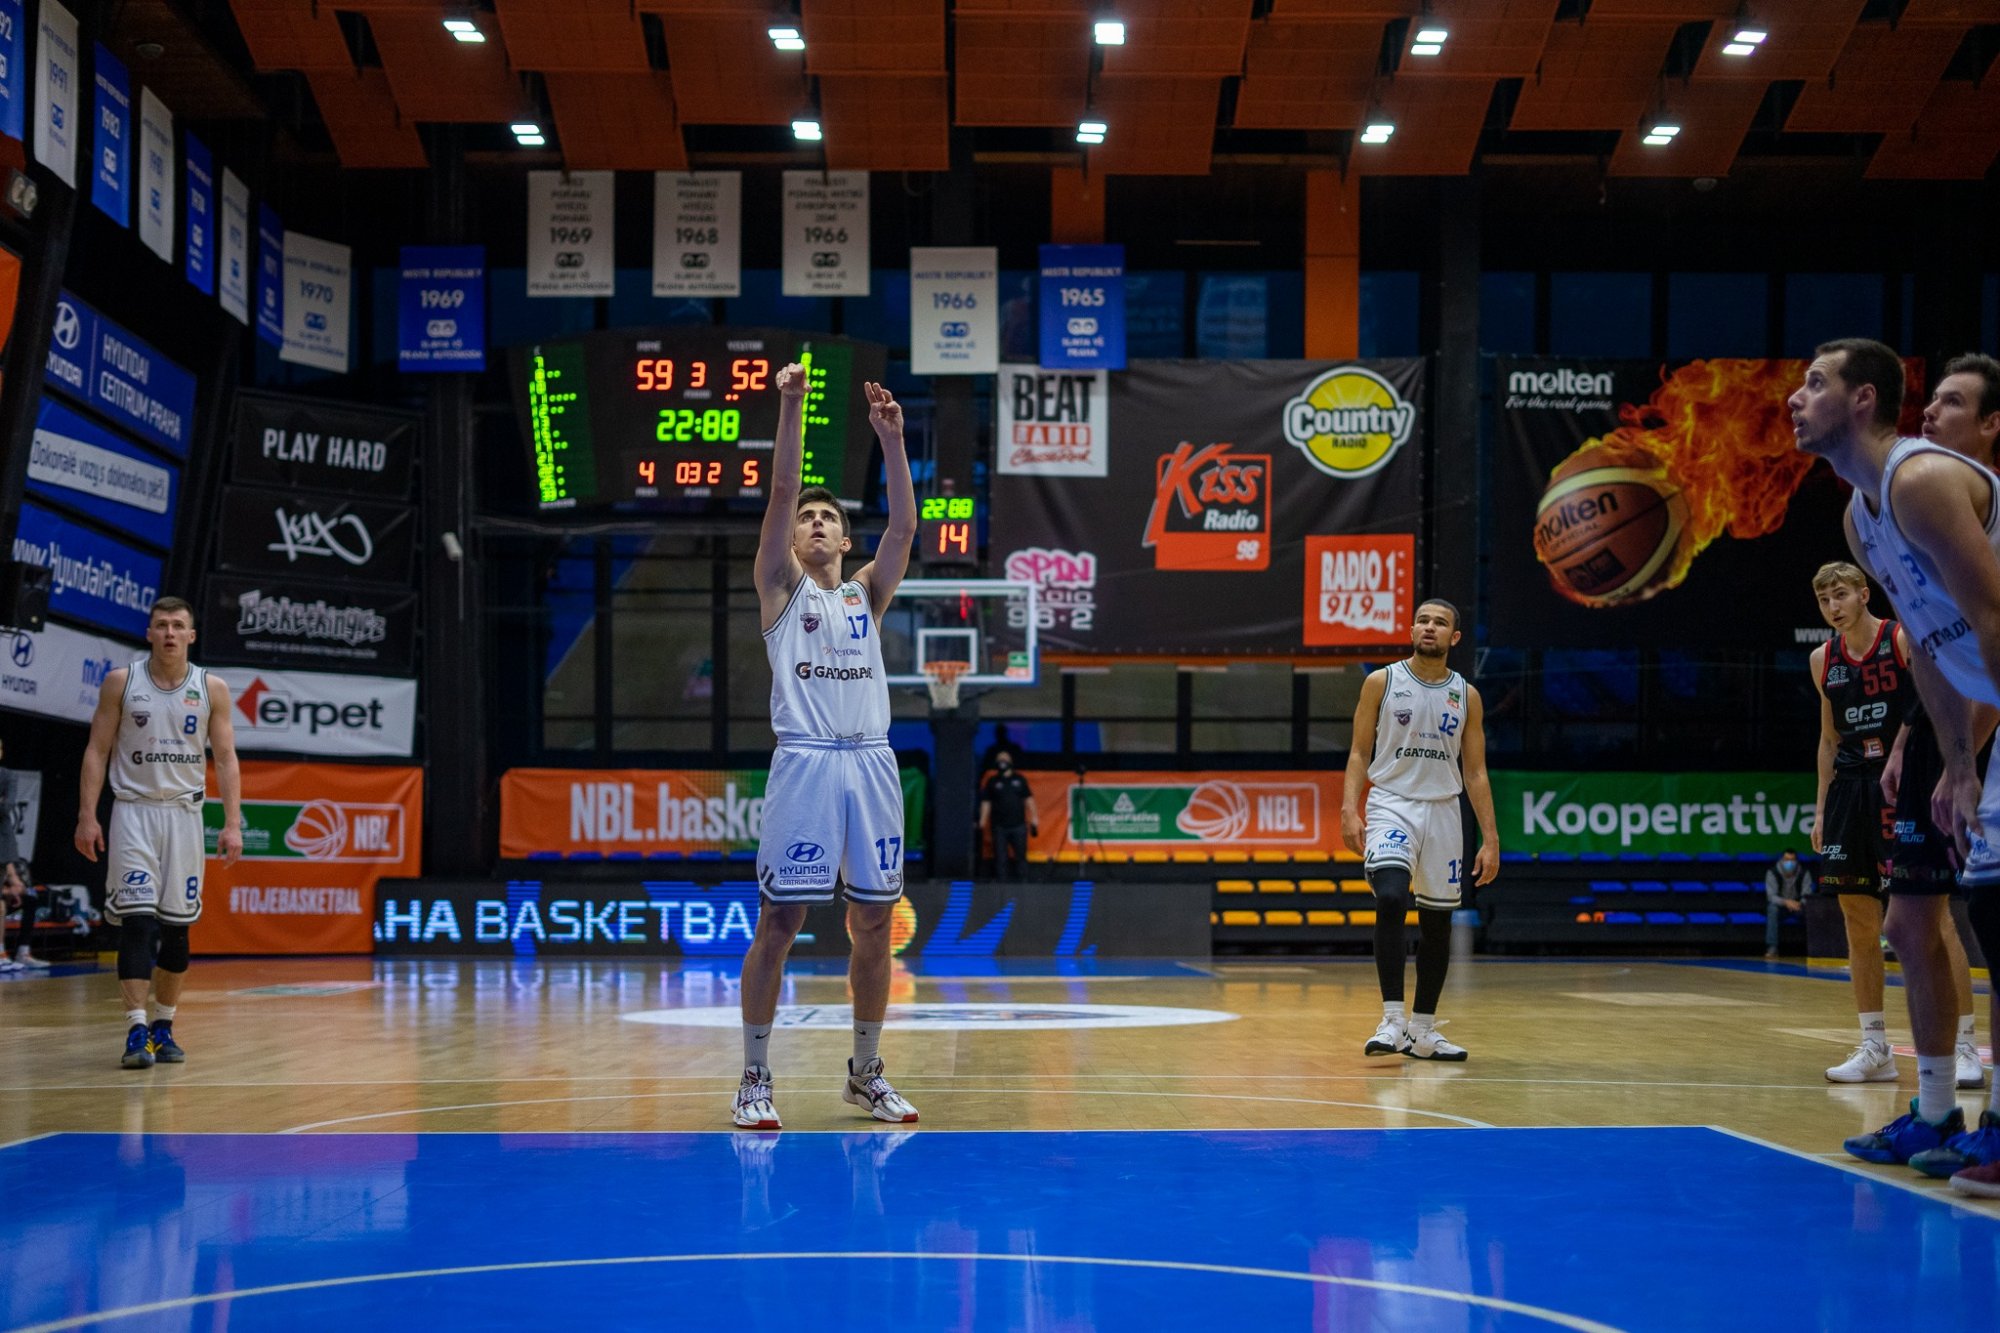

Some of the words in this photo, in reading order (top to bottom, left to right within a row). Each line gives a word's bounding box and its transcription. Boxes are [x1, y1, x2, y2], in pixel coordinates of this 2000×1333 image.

[549, 227, 593, 245] 1969
[675, 227, 719, 245] 1968
[804, 227, 848, 244] 1966
[300, 280, 334, 305] 1970
[420, 289, 465, 309] 1969
[932, 292, 977, 310] 1966
[1060, 288, 1105, 307] 1965
[636, 359, 674, 391] 59
[690, 361, 706, 388] 3
[731, 359, 769, 391] 52
[1508, 368, 1613, 396] molten
[1013, 373, 1096, 422] BEAT
[656, 409, 740, 442] 22:88
[1291, 402, 1407, 438] Country
[263, 428, 320, 464] PLAY
[326, 436, 387, 472] HARD
[1332, 437, 1367, 449] RADIO
[638, 461, 656, 485] 4
[743, 460, 759, 486] 5
[1142, 441, 1263, 546] Kiss
[1204, 509, 1259, 531] Radio
[1537, 491, 1618, 547] molten
[938, 523, 968, 554] 14
[1235, 540, 1260, 560] 98
[1008, 550, 1093, 585] SPIN
[1321, 550, 1382, 592] RADIO
[1386, 551, 1396, 592] 1
[1901, 552, 1927, 587] 3
[848, 613, 868, 640] 17
[833, 647, 863, 657] VCTORIA
[1862, 660, 1898, 697] 55
[183, 714, 198, 735] 8
[259, 696, 384, 735] erpet
[1438, 712, 1459, 737] 12
[1845, 701, 1888, 724] era
[1257, 795, 1305, 832] NBL
[1522, 791, 1818, 847] Kooperativa
[353, 815, 392, 851] NBL
[875, 836, 901, 871] 17
[779, 865, 830, 875] HYUNDAI
[779, 878, 809, 886] CENTRUM
[810, 878, 830, 886] PRAHA
[186, 875, 198, 900] 8
[229, 885, 363, 916] #TOJEBASKETBAL
[475, 901, 815, 943] BASKETBA
